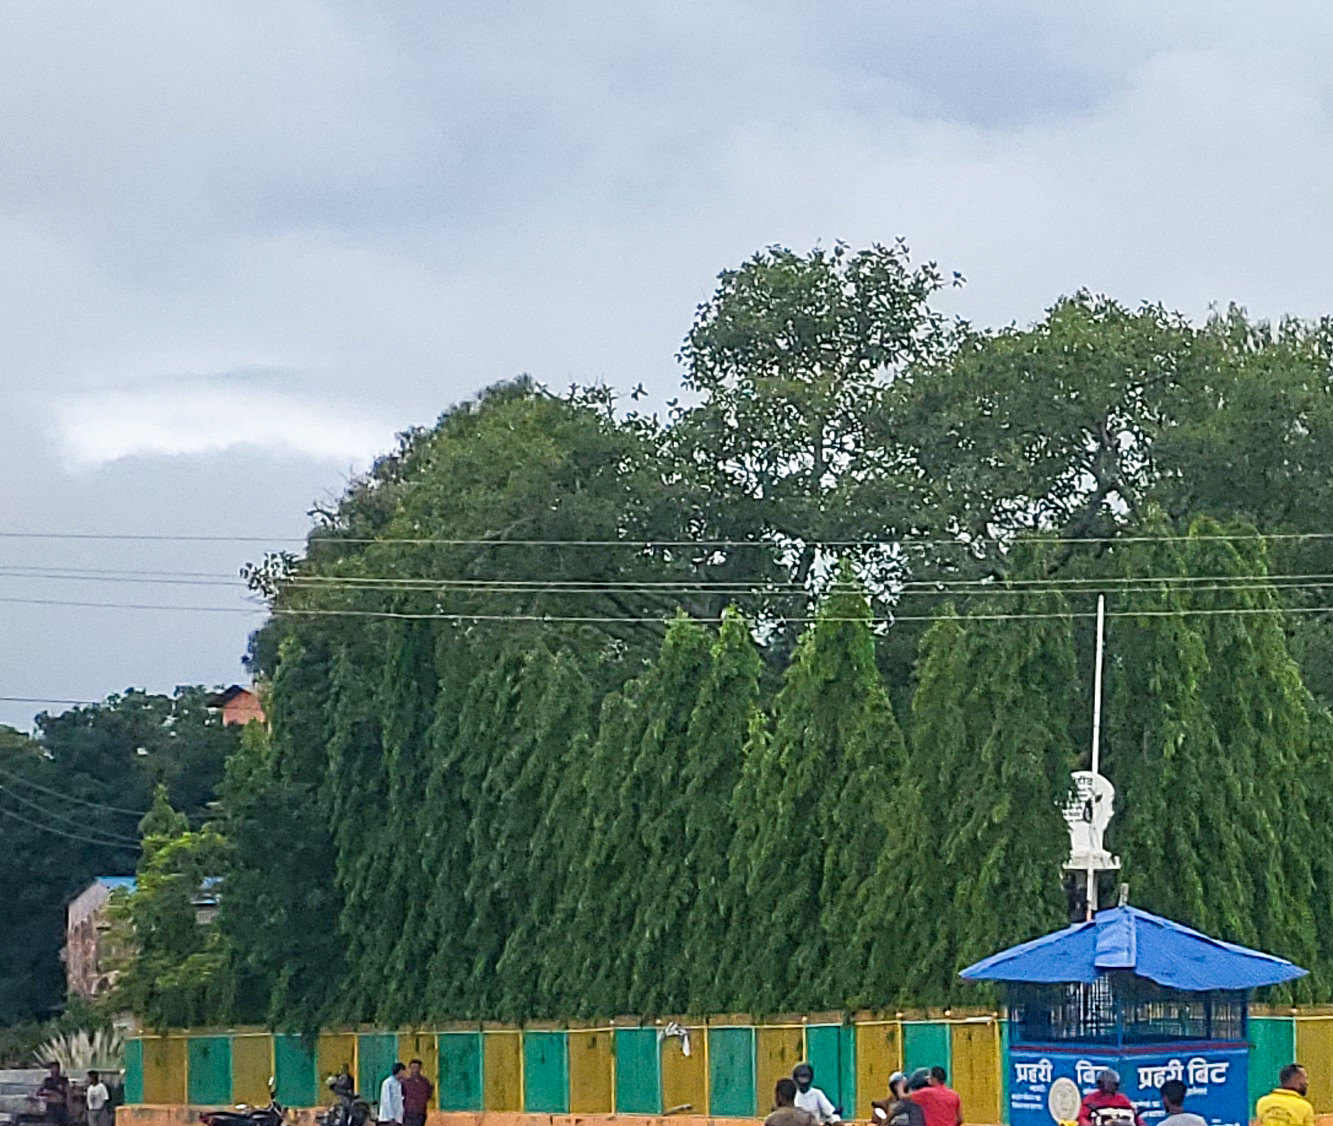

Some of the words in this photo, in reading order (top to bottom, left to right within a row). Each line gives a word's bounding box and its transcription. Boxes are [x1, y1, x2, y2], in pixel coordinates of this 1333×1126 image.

[1014, 1058, 1053, 1083] प्रहरी
[1075, 1060, 1110, 1084] बि
[1137, 1058, 1184, 1090] प्रहरी
[1187, 1057, 1230, 1085] बिट
